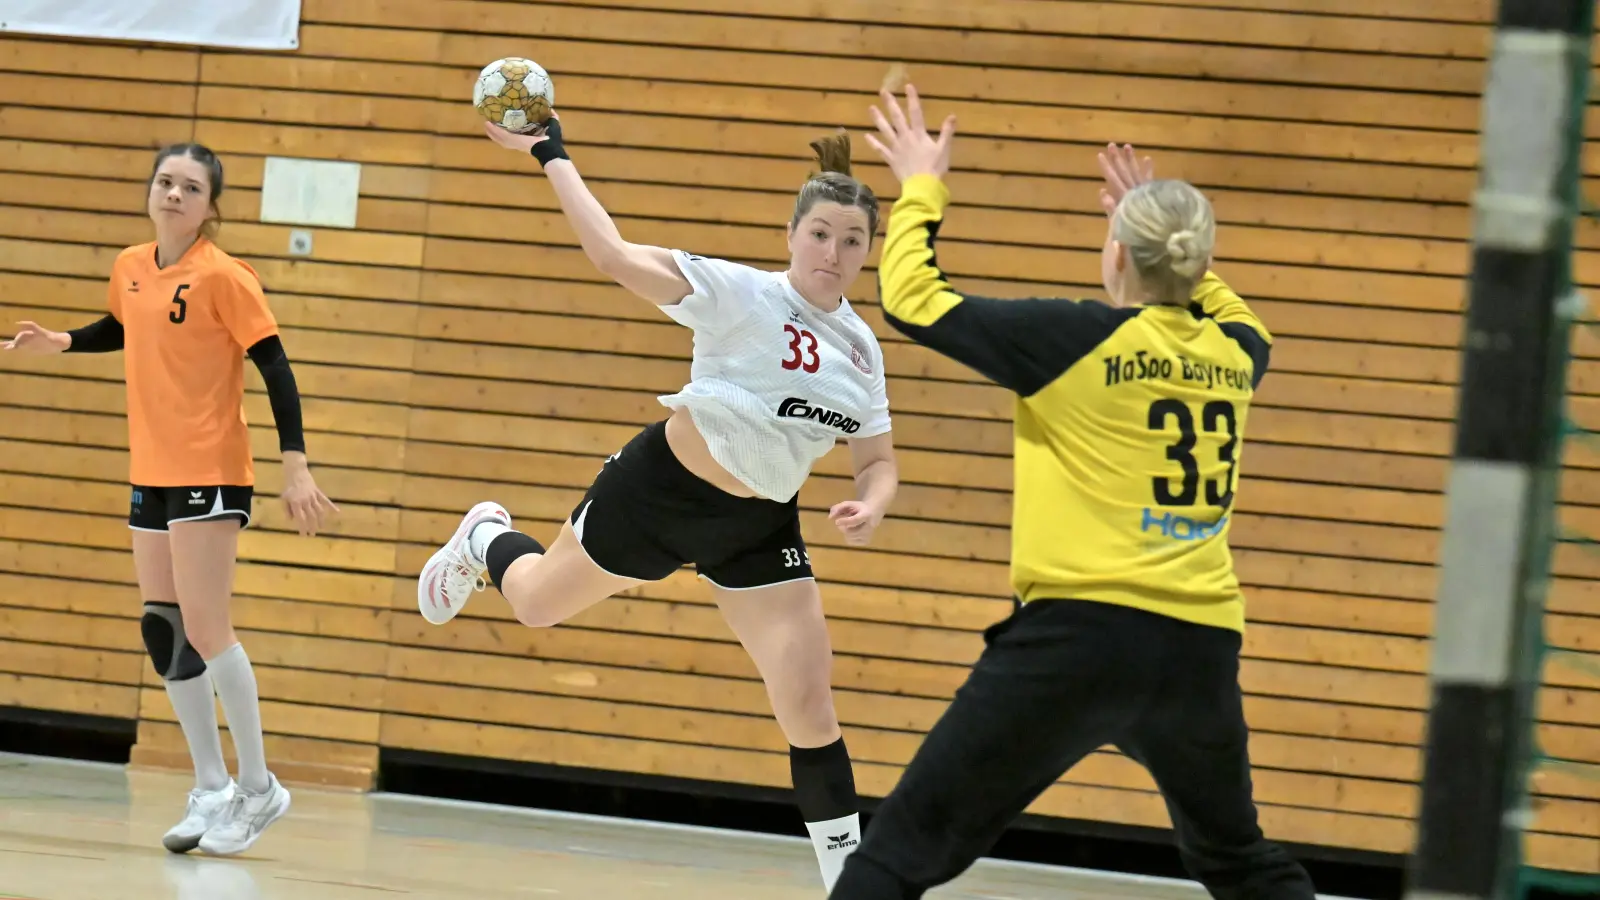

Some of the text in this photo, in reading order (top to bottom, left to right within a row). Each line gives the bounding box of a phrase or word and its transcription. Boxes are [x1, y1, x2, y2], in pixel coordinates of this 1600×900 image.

[169, 284, 190, 324] 5
[781, 324, 820, 374] 33
[777, 397, 861, 434] CONRAD
[1147, 398, 1237, 508] 33
[781, 547, 801, 568] 33
[827, 839, 857, 850] erima
